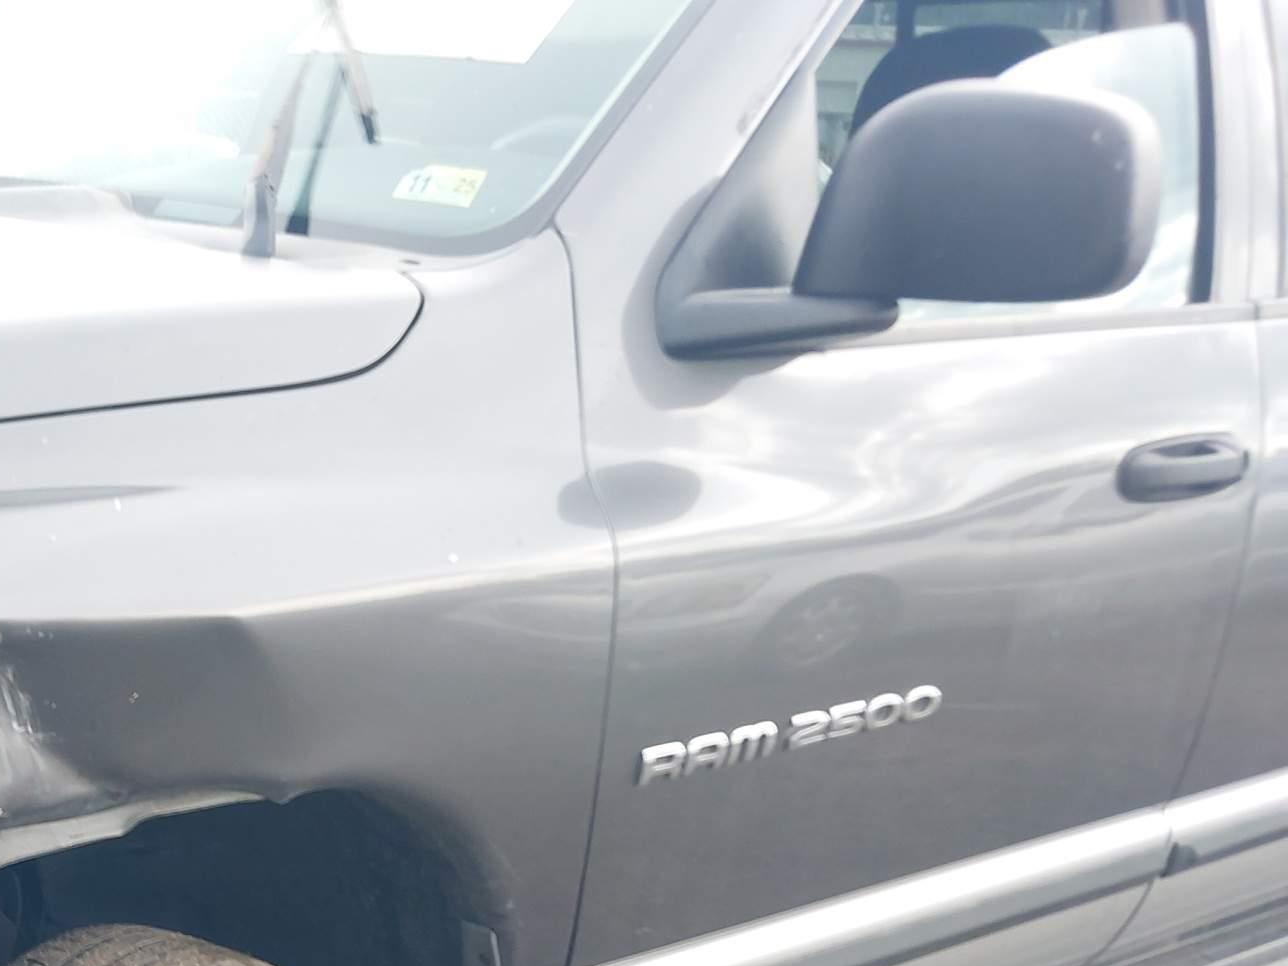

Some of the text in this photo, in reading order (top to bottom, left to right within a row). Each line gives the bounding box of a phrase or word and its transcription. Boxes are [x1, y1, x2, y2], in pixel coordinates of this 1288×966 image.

[408, 173, 432, 193] 11
[637, 685, 943, 787] RAM 2500
